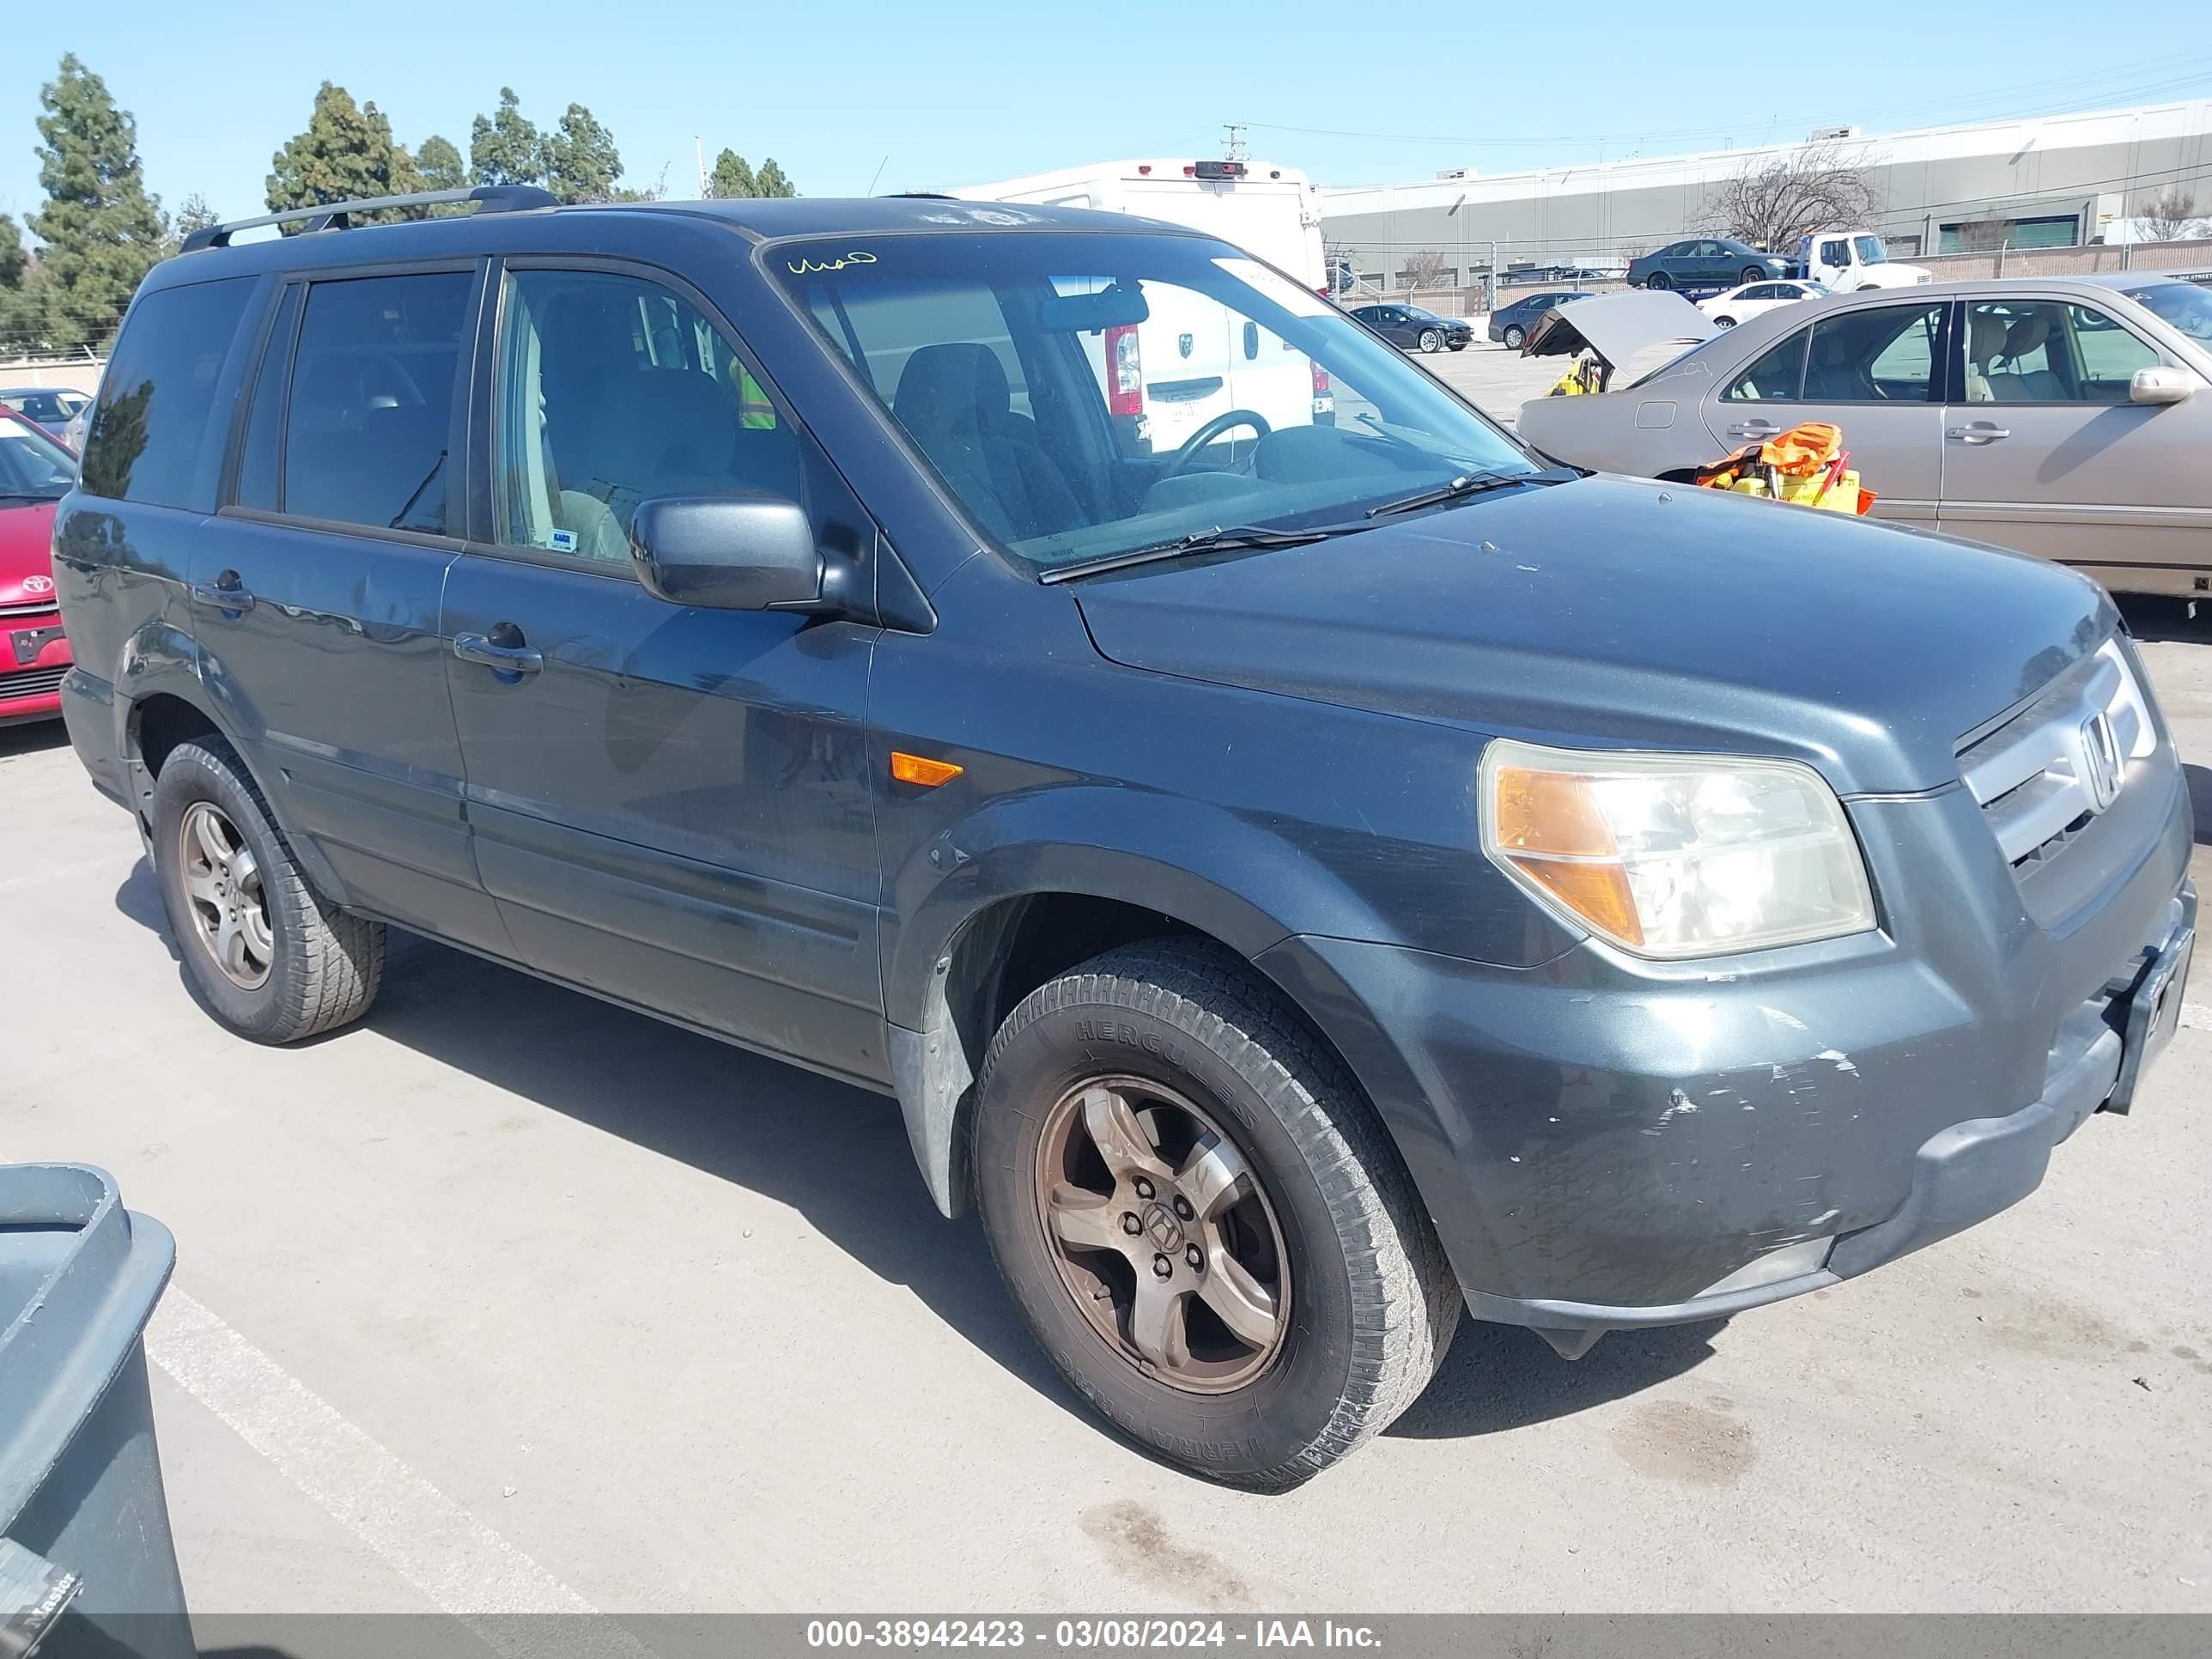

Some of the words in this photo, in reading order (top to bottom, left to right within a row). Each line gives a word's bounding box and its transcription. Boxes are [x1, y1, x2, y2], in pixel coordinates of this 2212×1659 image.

[1074, 1019, 1261, 1130] HERCULES
[1055, 1349, 1137, 1435] TRAC
[1152, 1427, 1269, 1463] TERRA
[23, 1572, 76, 1629] Master
